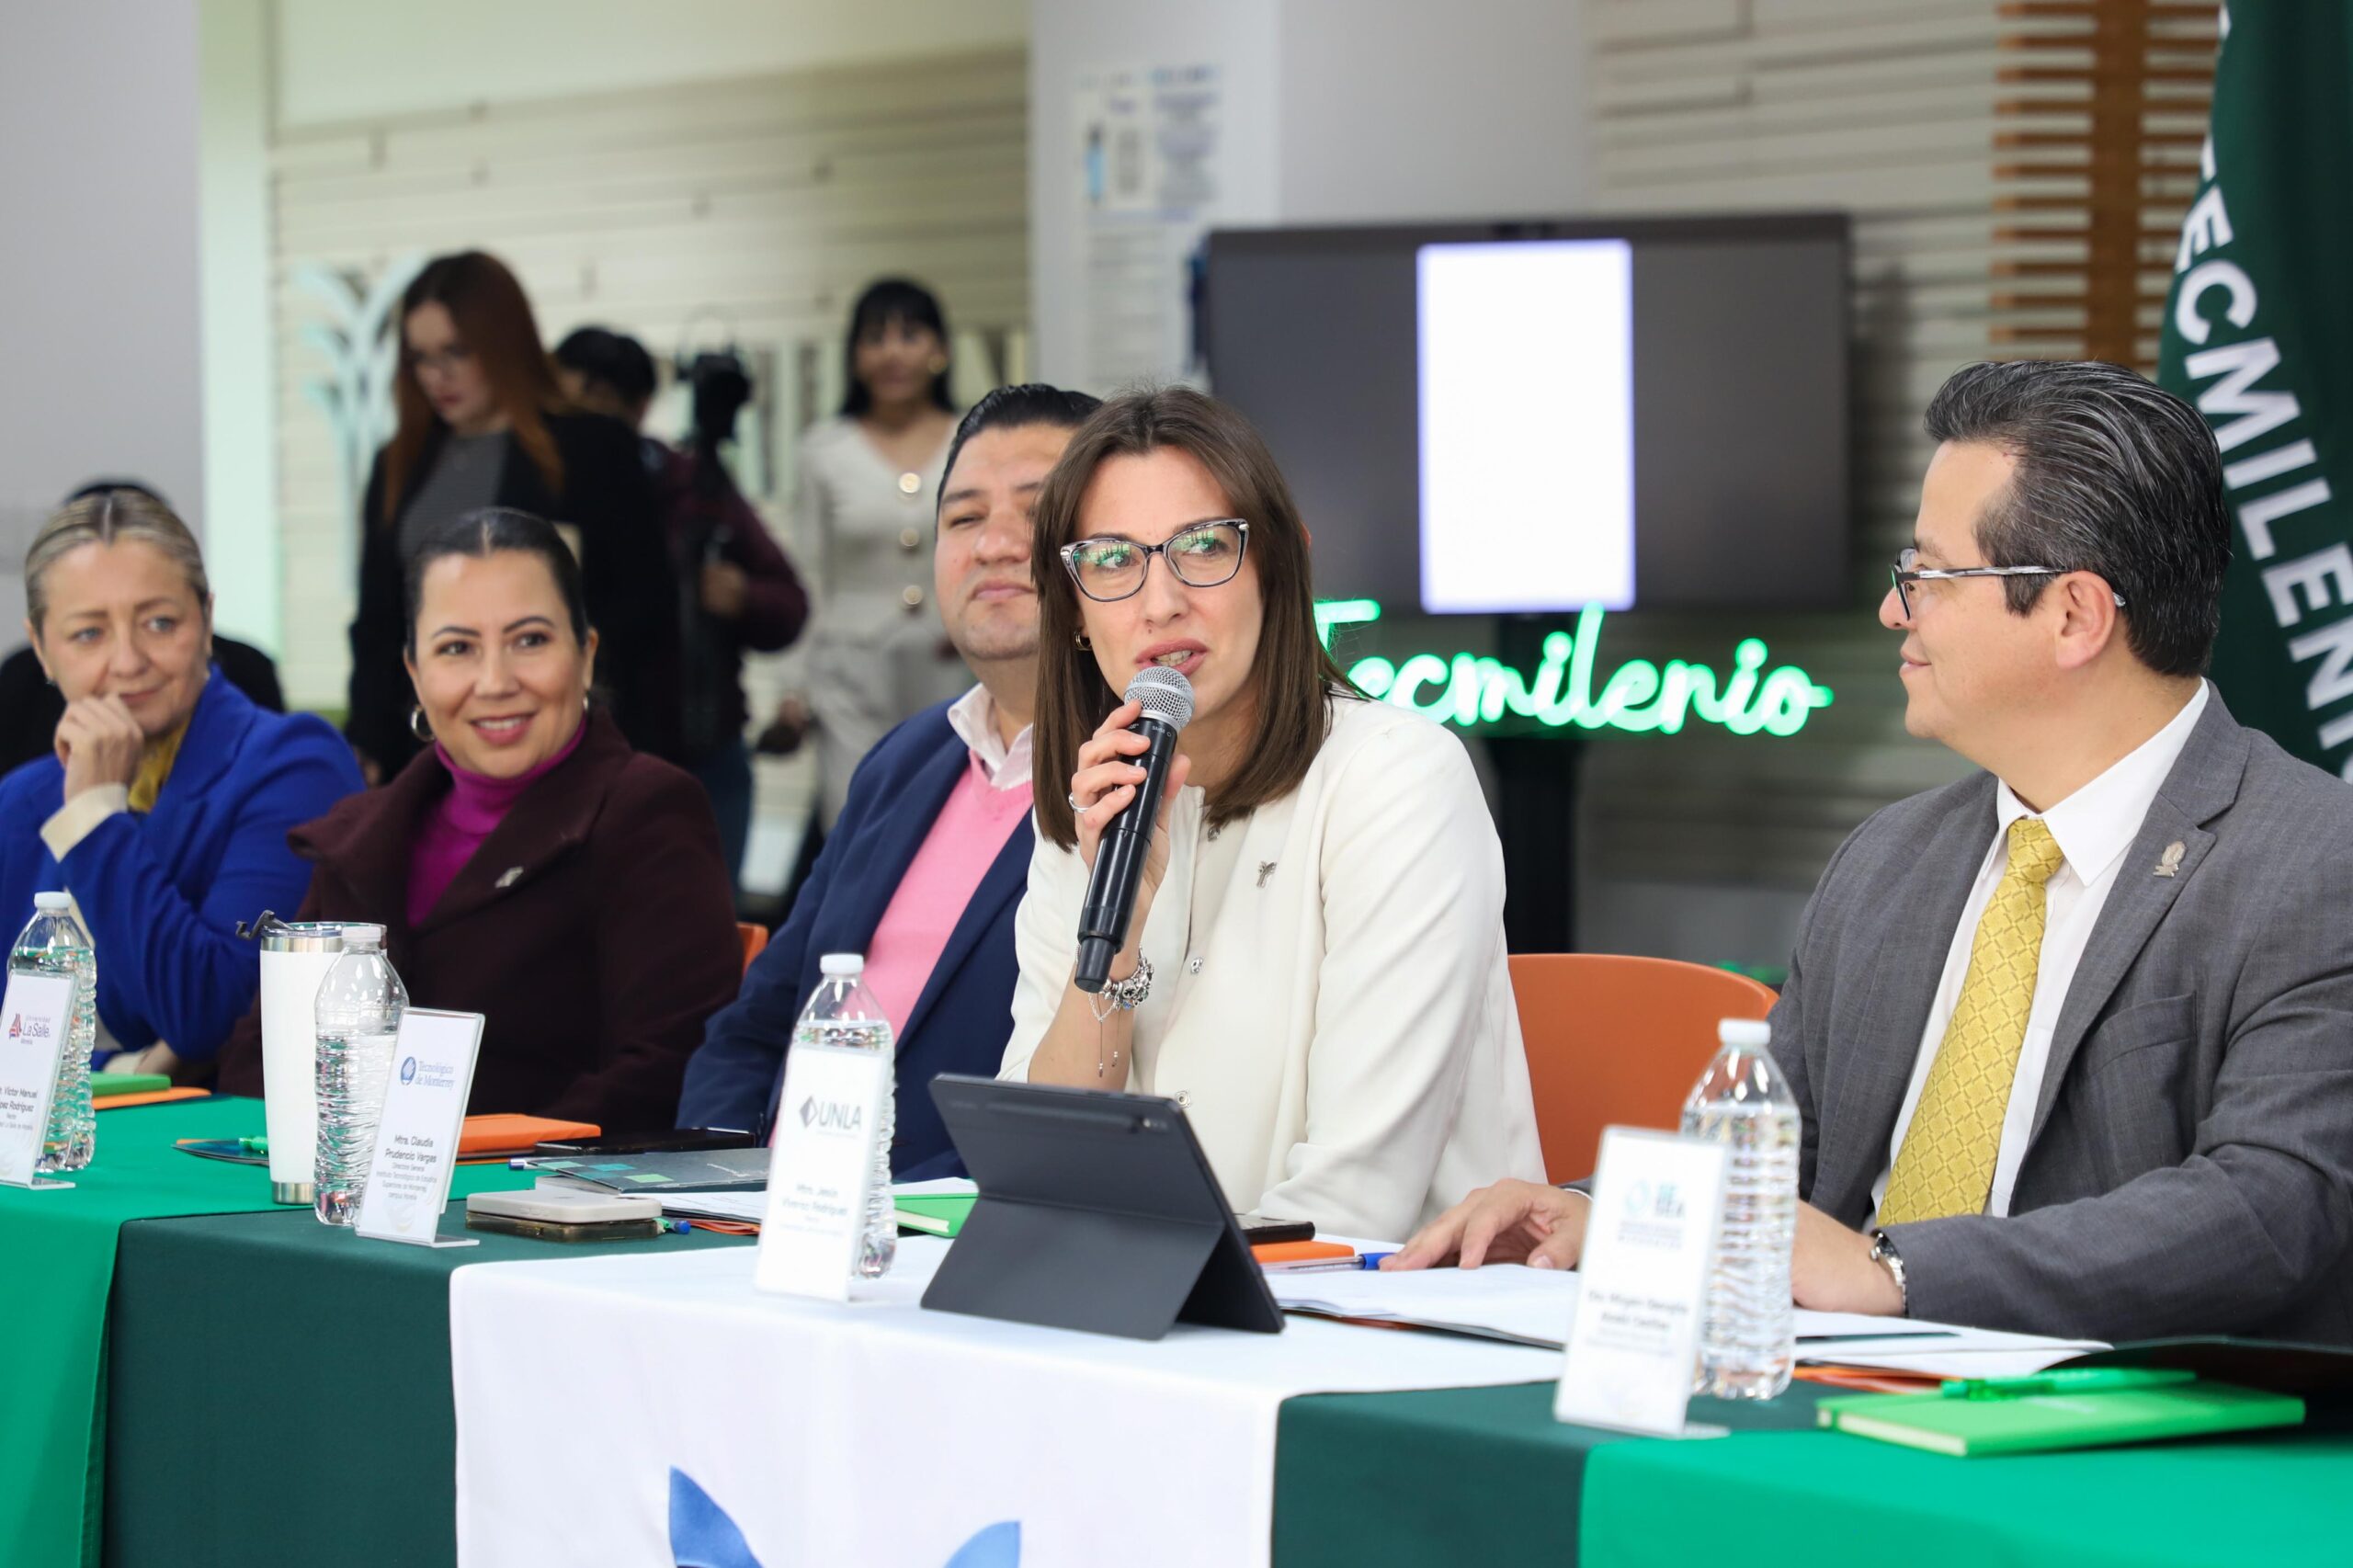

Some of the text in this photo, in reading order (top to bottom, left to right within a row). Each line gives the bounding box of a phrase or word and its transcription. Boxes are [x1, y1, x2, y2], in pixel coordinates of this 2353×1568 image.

[2175, 133, 2353, 785] ECMILEN
[424, 1074, 456, 1091] Monterrey
[819, 1101, 862, 1130] UNLA
[411, 1136, 434, 1148] Claudia
[384, 1148, 437, 1165] Prudencio Vargas
